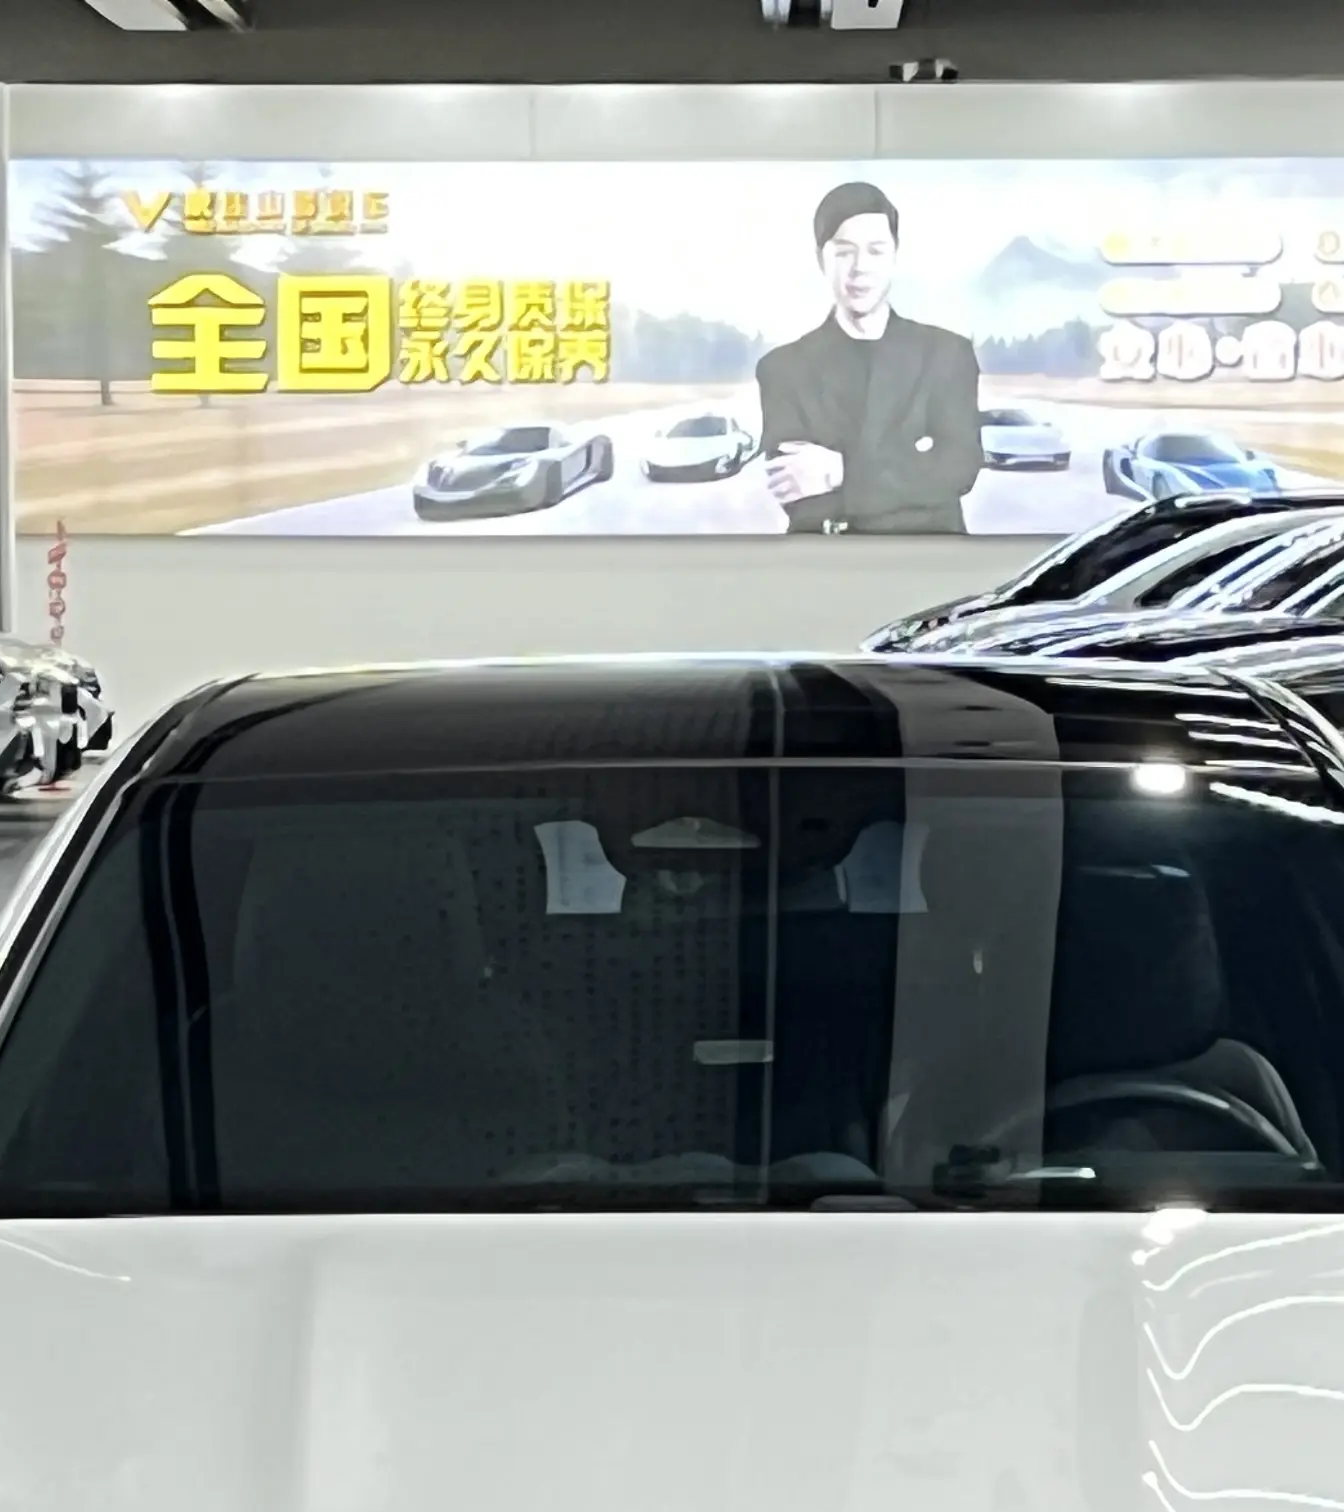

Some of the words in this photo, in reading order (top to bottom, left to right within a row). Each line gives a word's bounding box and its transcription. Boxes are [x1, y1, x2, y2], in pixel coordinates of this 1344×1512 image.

[399, 278, 610, 331] 终身质保
[147, 274, 392, 392] 全国
[399, 329, 610, 384] 永久保养
